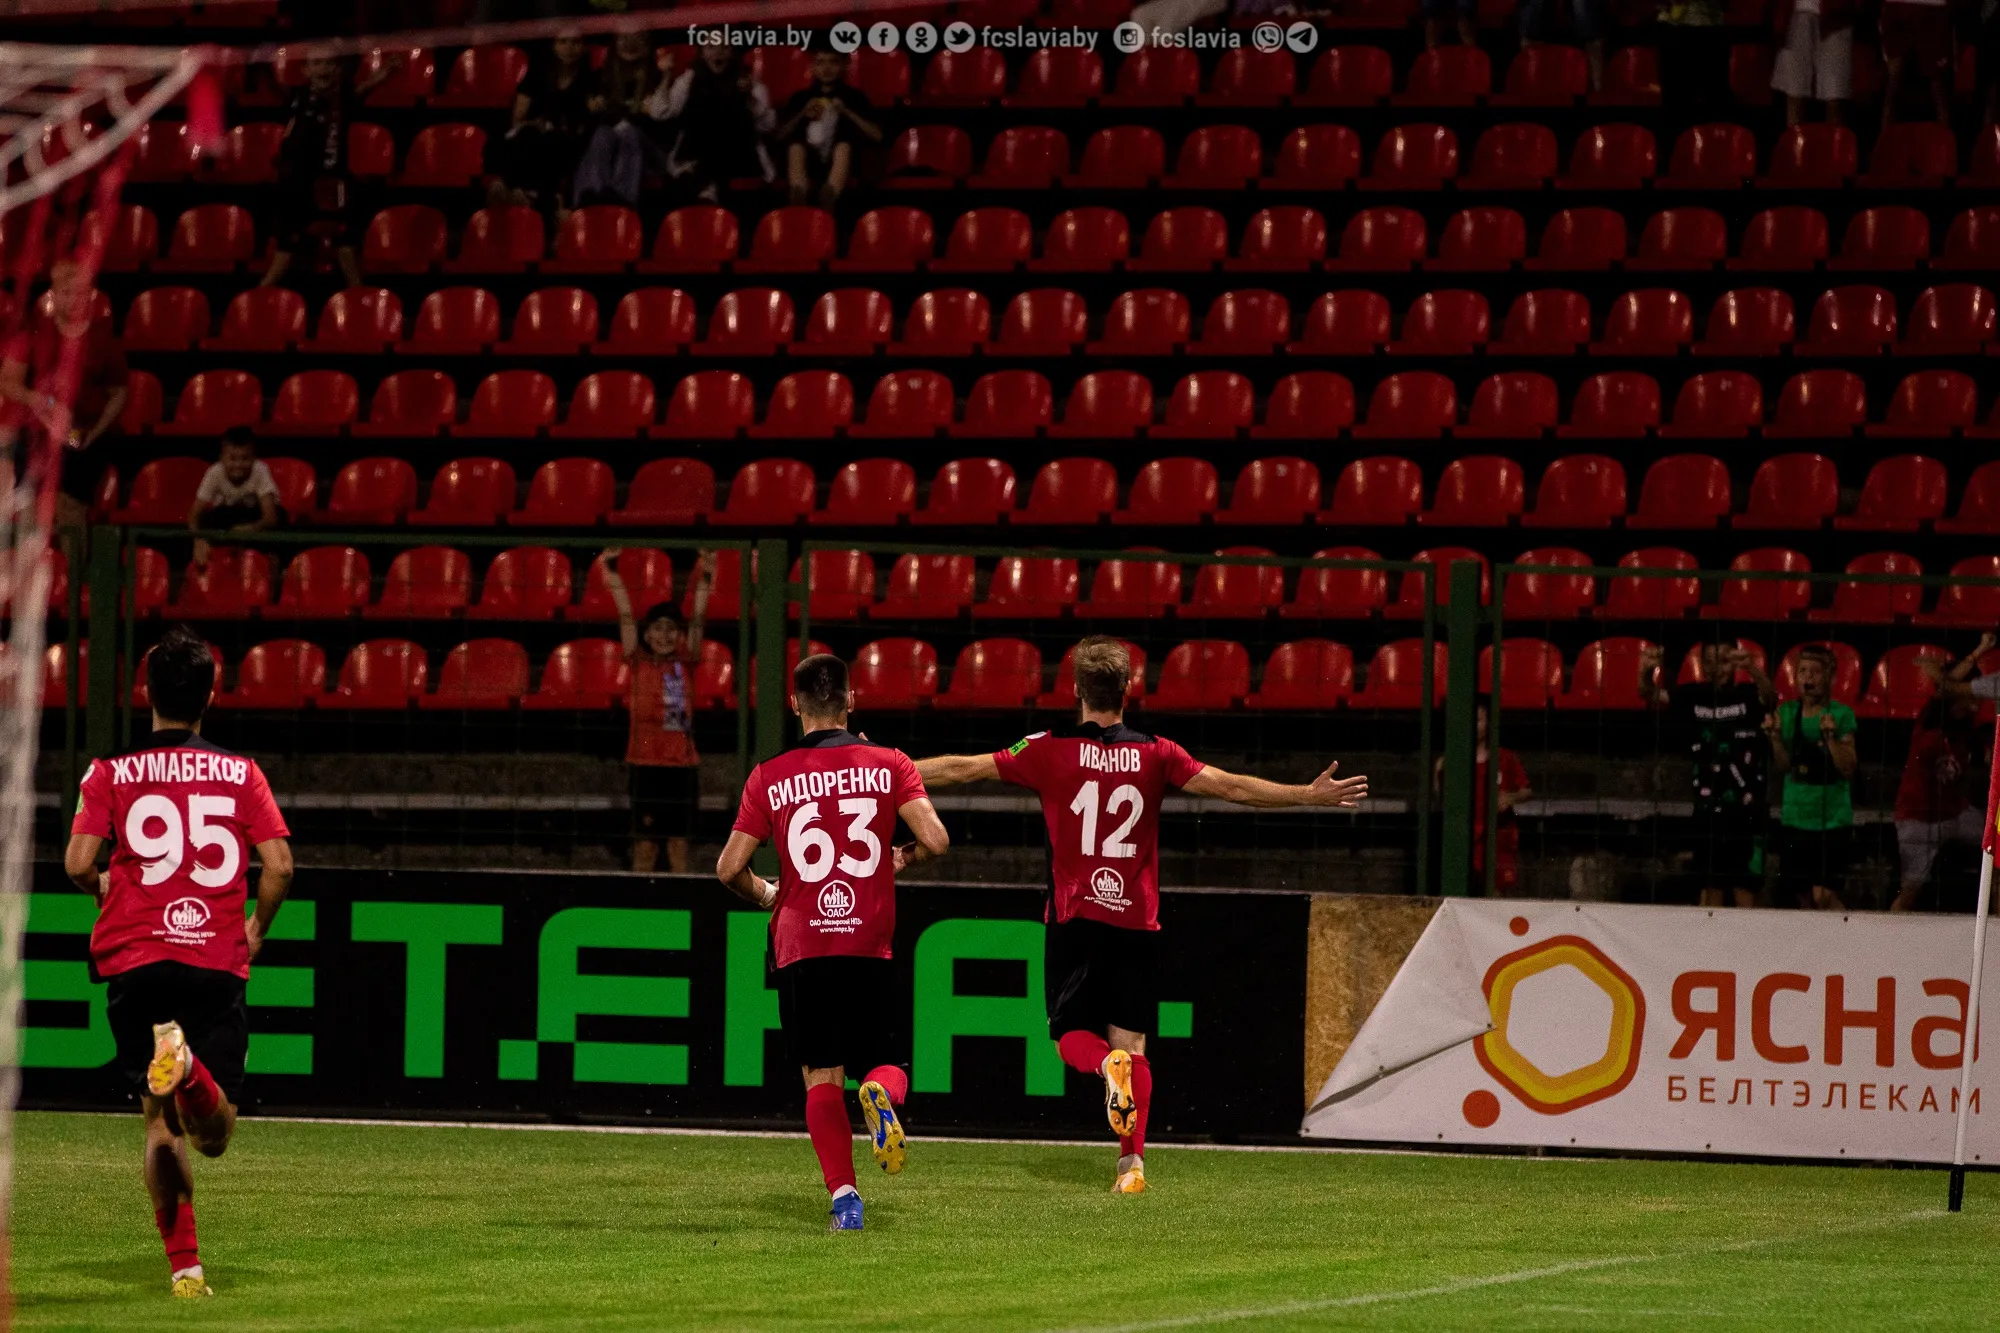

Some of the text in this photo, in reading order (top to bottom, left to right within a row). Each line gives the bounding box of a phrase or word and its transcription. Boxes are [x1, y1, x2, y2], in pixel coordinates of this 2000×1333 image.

[110, 752, 247, 785] ЖУМАБЕКОВ
[1079, 743, 1141, 773] ИВАНОВ
[767, 767, 892, 811] СИДОРЕНКО
[787, 797, 881, 883] 63
[1069, 780, 1144, 858] 12
[125, 793, 240, 888] 95
[826, 908, 846, 918] ОАО
[1667, 1075, 1981, 1115] БЕЛТЭЛЕКАМ
